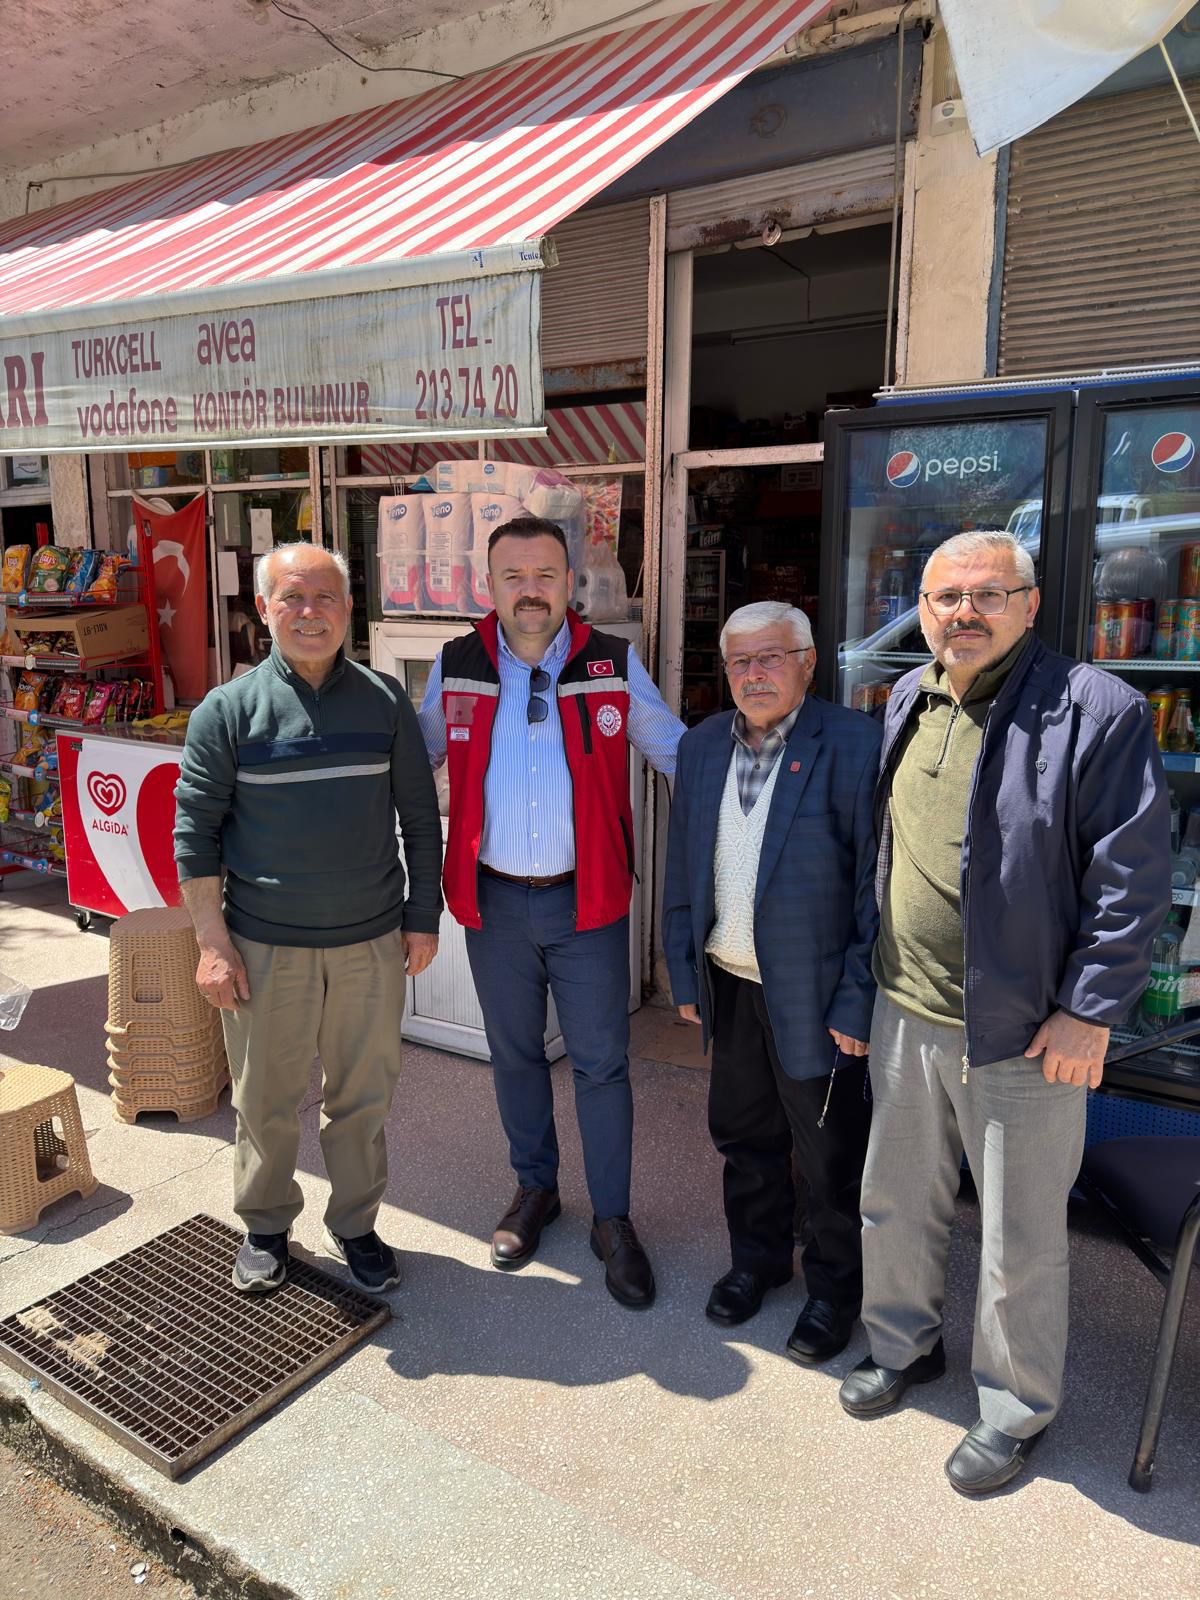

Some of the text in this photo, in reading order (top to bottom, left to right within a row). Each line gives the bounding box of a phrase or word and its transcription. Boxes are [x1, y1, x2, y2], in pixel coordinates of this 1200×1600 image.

[71, 318, 256, 379] TURKCELL avea
[0, 351, 48, 428] RI
[77, 387, 178, 438] vodafone
[193, 377, 268, 433] KONTÖR
[415, 364, 519, 420] 213 74 20
[925, 450, 998, 482] pepsi
